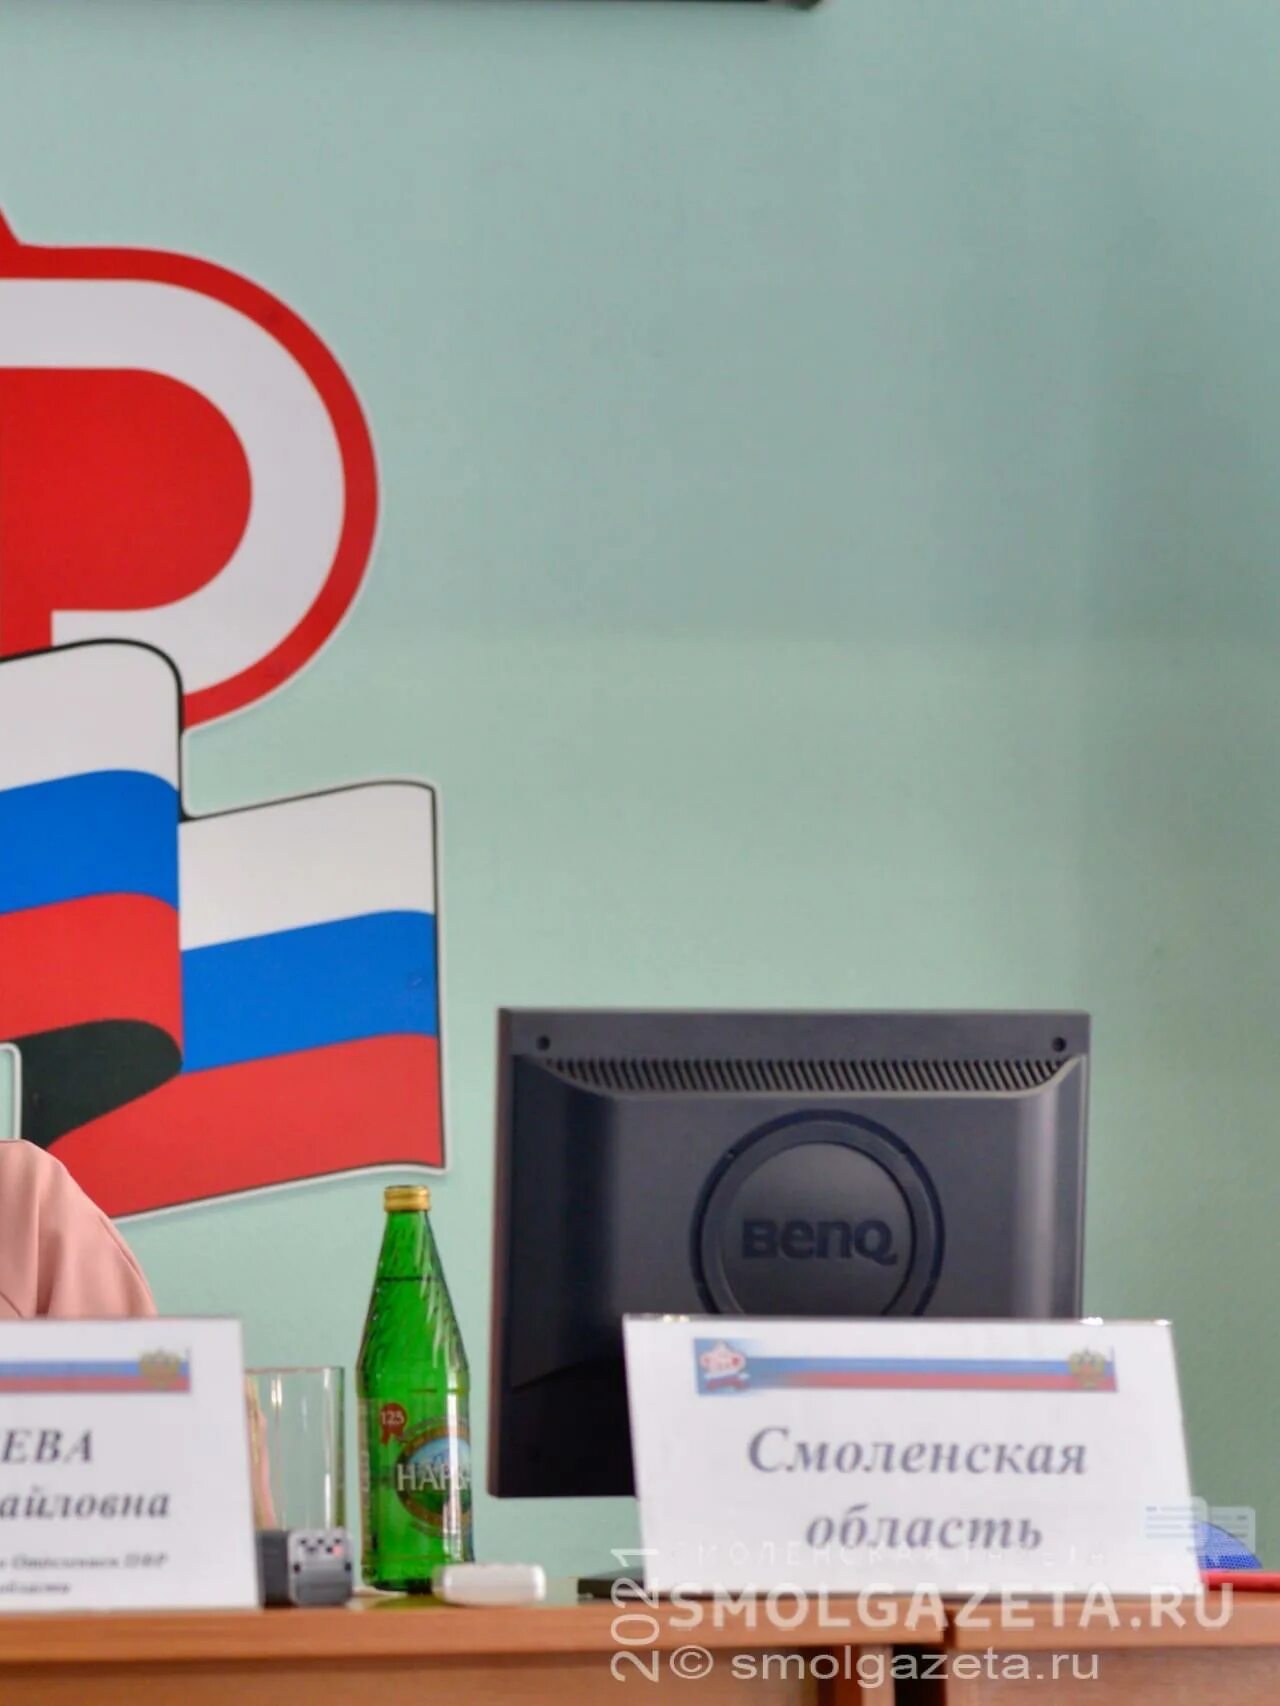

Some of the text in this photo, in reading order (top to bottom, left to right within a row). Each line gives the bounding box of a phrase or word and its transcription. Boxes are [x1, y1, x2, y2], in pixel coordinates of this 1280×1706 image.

[741, 1219, 898, 1266] BenQ
[747, 1427, 1088, 1475] Смоленская
[806, 1504, 1044, 1551] область
